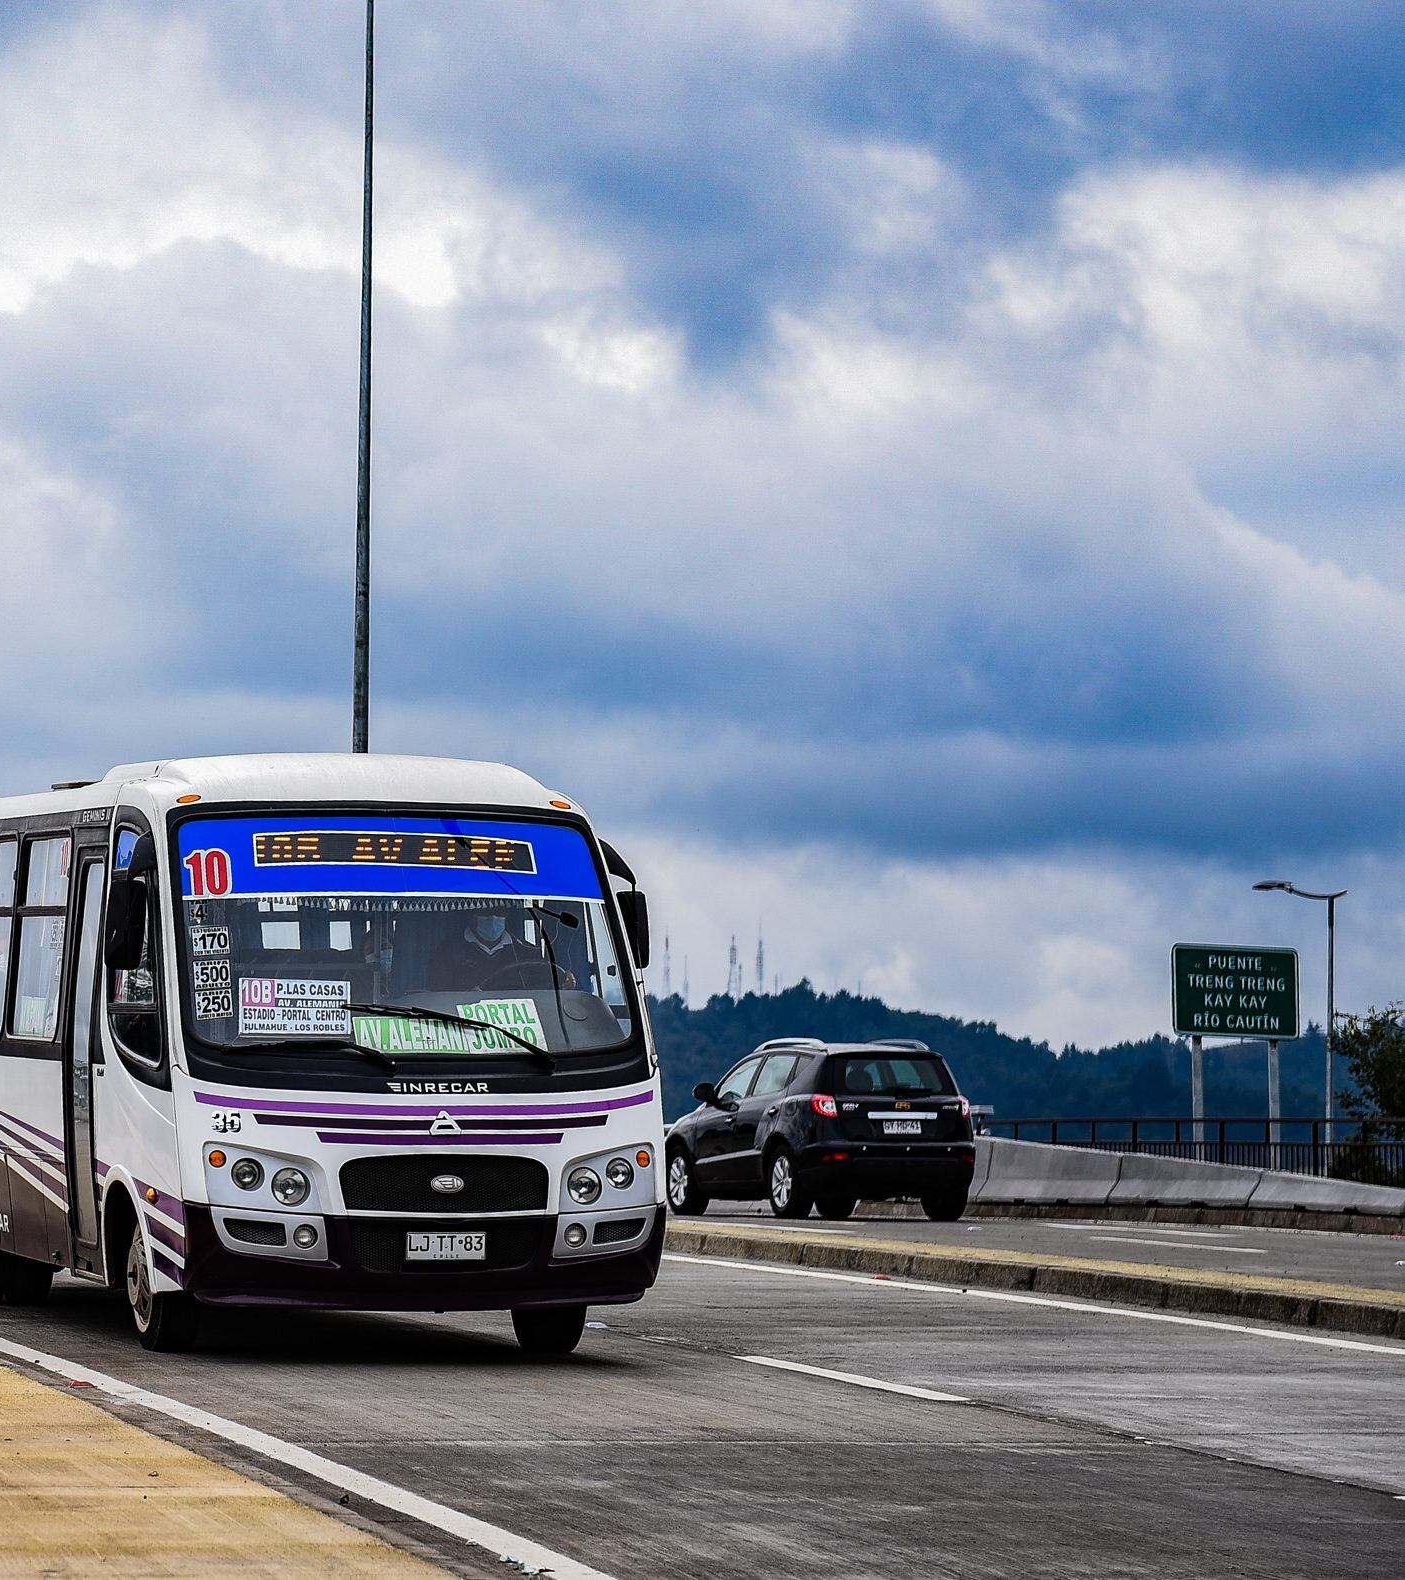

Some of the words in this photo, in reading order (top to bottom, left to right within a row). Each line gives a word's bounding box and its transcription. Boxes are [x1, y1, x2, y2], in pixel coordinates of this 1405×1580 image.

[184, 848, 232, 897] 10
[194, 933, 228, 950] $170
[1208, 954, 1262, 971] PUENTE
[195, 966, 229, 983] $500
[1187, 973, 1234, 990] TRENG
[1240, 976, 1285, 992] TRENG
[243, 980, 272, 1004] 10B
[309, 984, 344, 996] CASAS
[197, 995, 231, 1013] $250
[278, 999, 293, 1007] AV.
[1204, 993, 1233, 1008] KAY
[1239, 994, 1268, 1009] KAY
[243, 1008, 275, 1020] ESTADIO
[281, 1009, 311, 1021] PORTAL
[315, 1010, 346, 1021] CENTRO
[462, 1003, 536, 1025] PORTAL
[403, 1082, 489, 1093] INRECAR
[211, 1110, 242, 1134] 35
